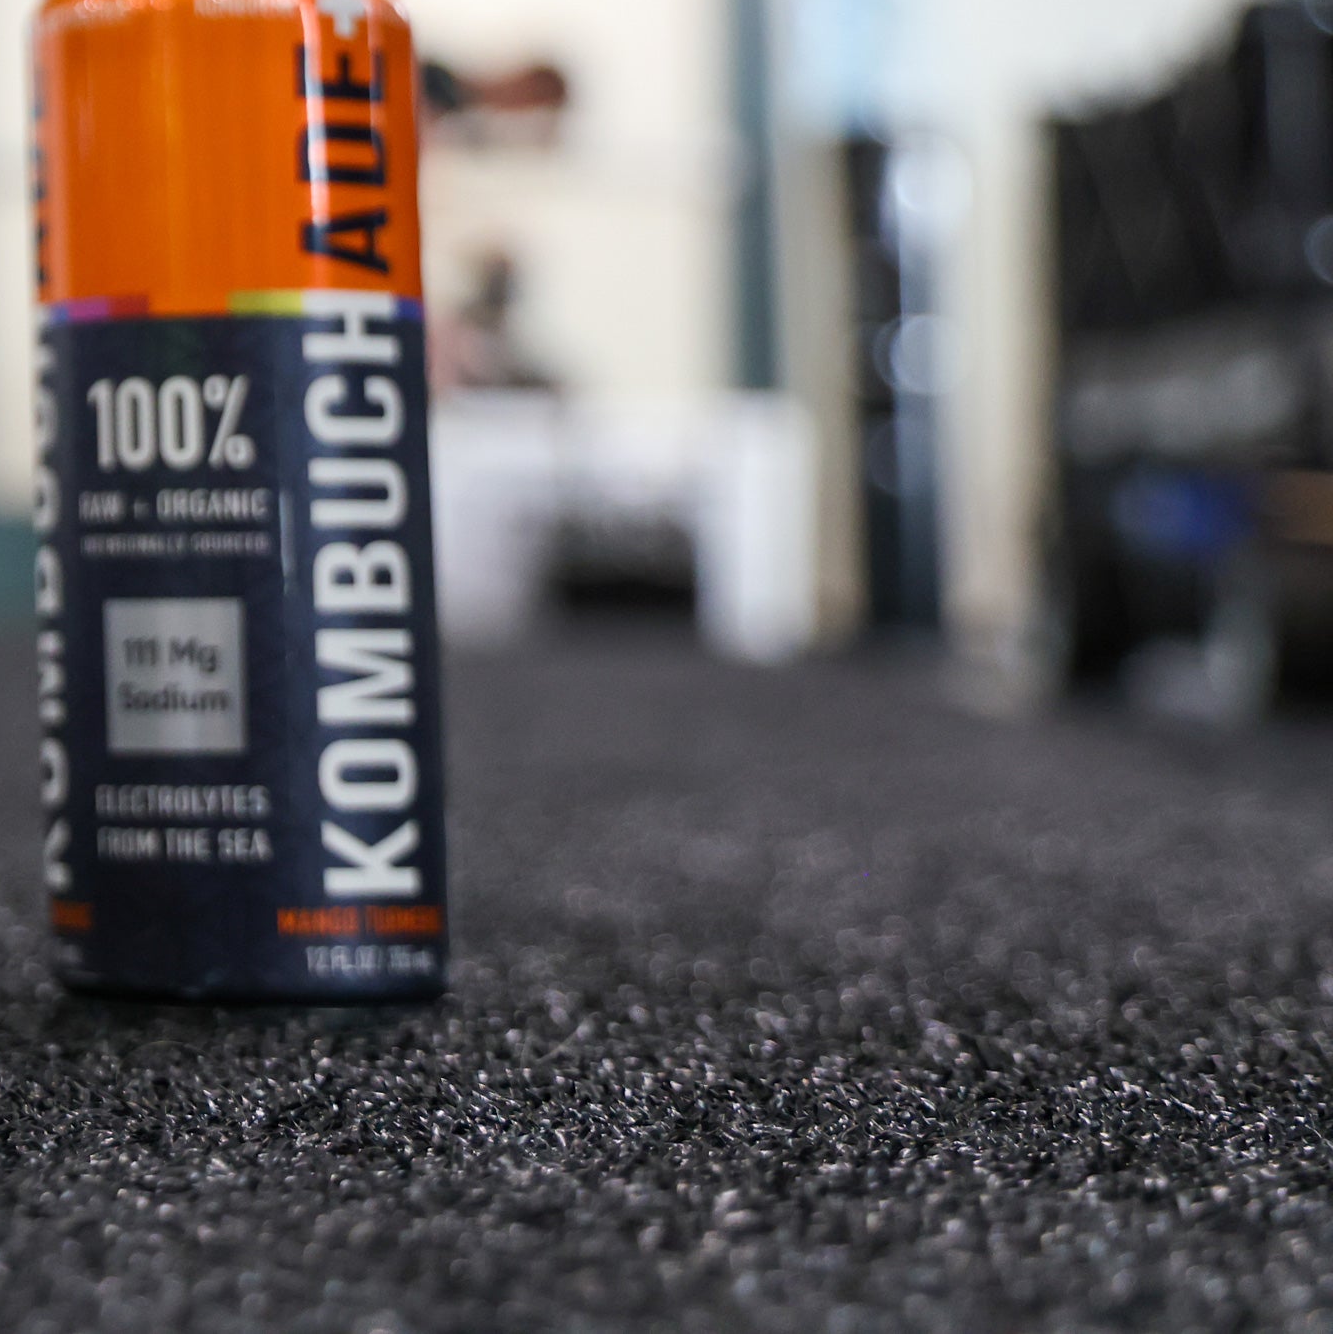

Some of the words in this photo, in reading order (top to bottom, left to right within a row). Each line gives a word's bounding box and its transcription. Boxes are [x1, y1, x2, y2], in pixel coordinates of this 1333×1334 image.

[87, 373, 257, 472] 100%
[156, 487, 273, 522] ORGANIC
[167, 635, 220, 678] Mg
[117, 676, 231, 714] Sodium
[95, 782, 271, 817] ELECTROLYTES
[162, 826, 211, 859] THE
[217, 825, 273, 860] SEA
